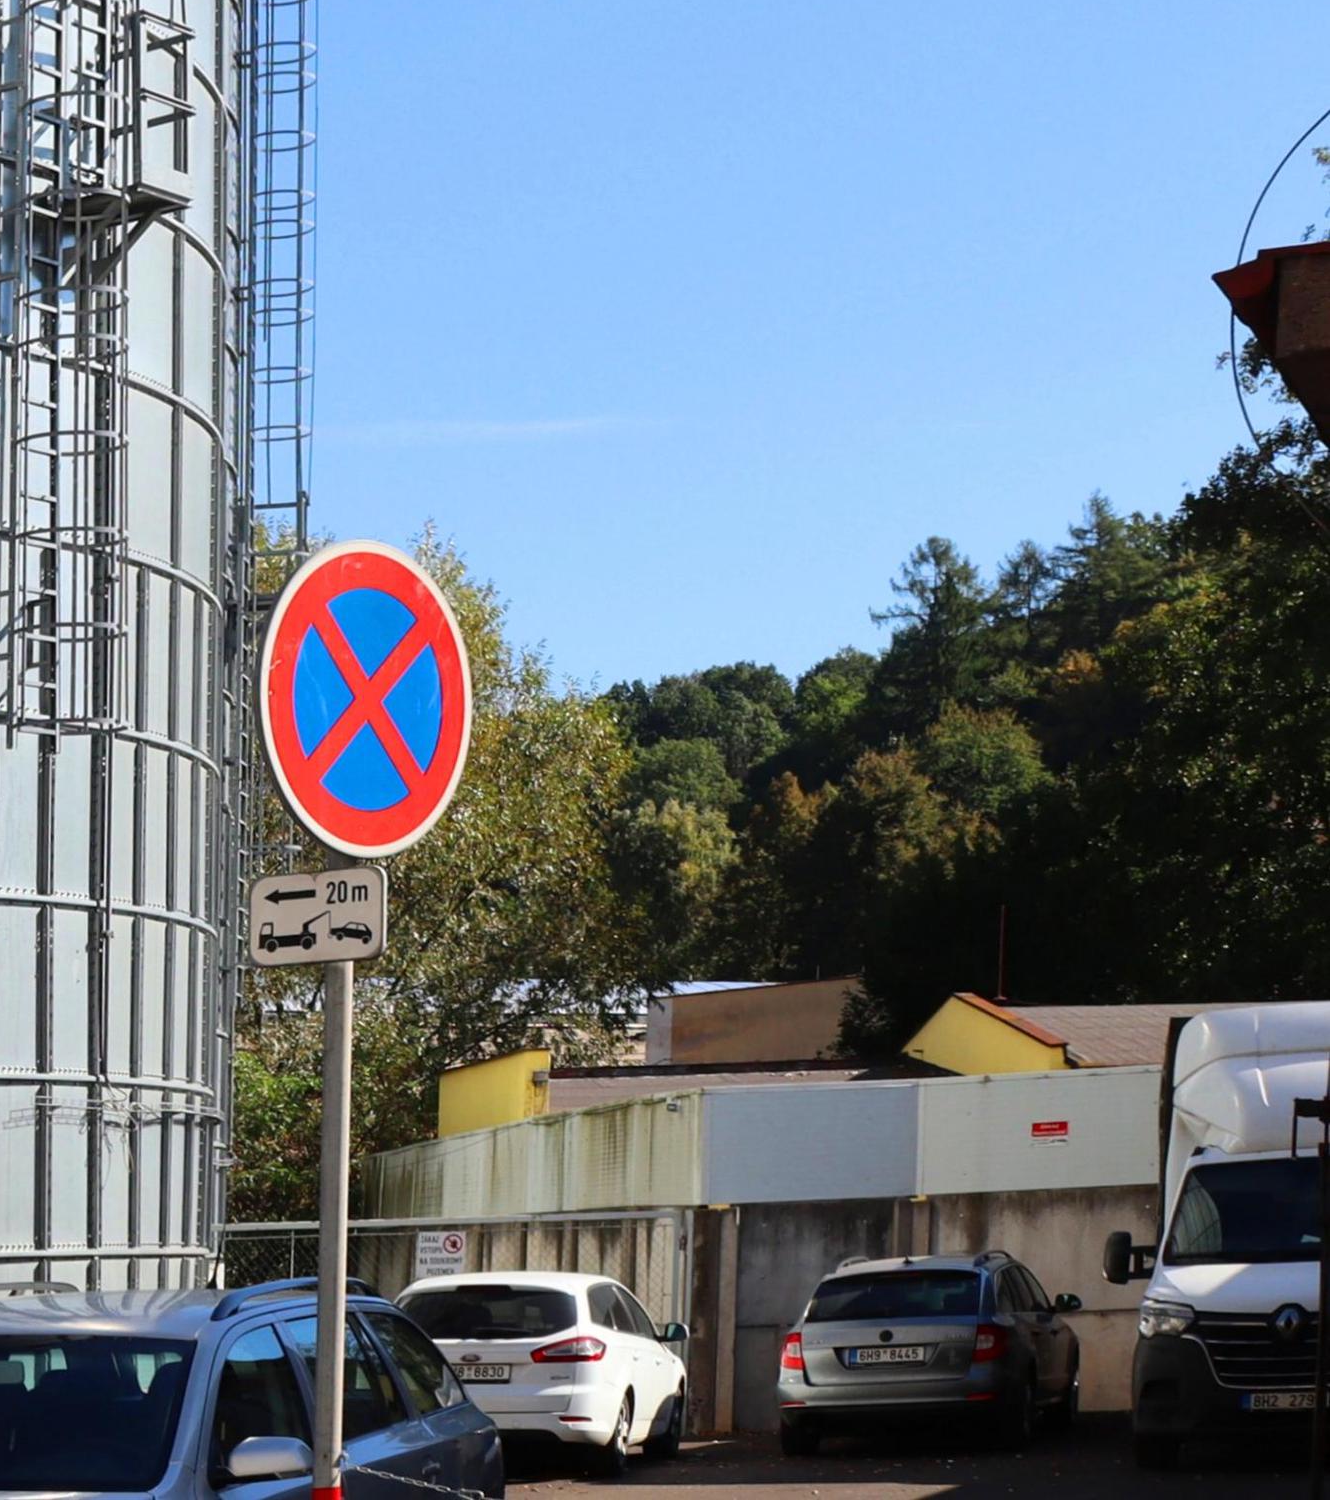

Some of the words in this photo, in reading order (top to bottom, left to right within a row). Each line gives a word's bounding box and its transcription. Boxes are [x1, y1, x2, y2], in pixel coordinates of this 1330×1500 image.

[326, 880, 348, 904] 20
[351, 885, 368, 903] m
[859, 1349, 881, 1361] 6H9
[889, 1348, 919, 1360] 8445
[474, 1366, 504, 1378] 8830
[1289, 1393, 1315, 1407] 279
